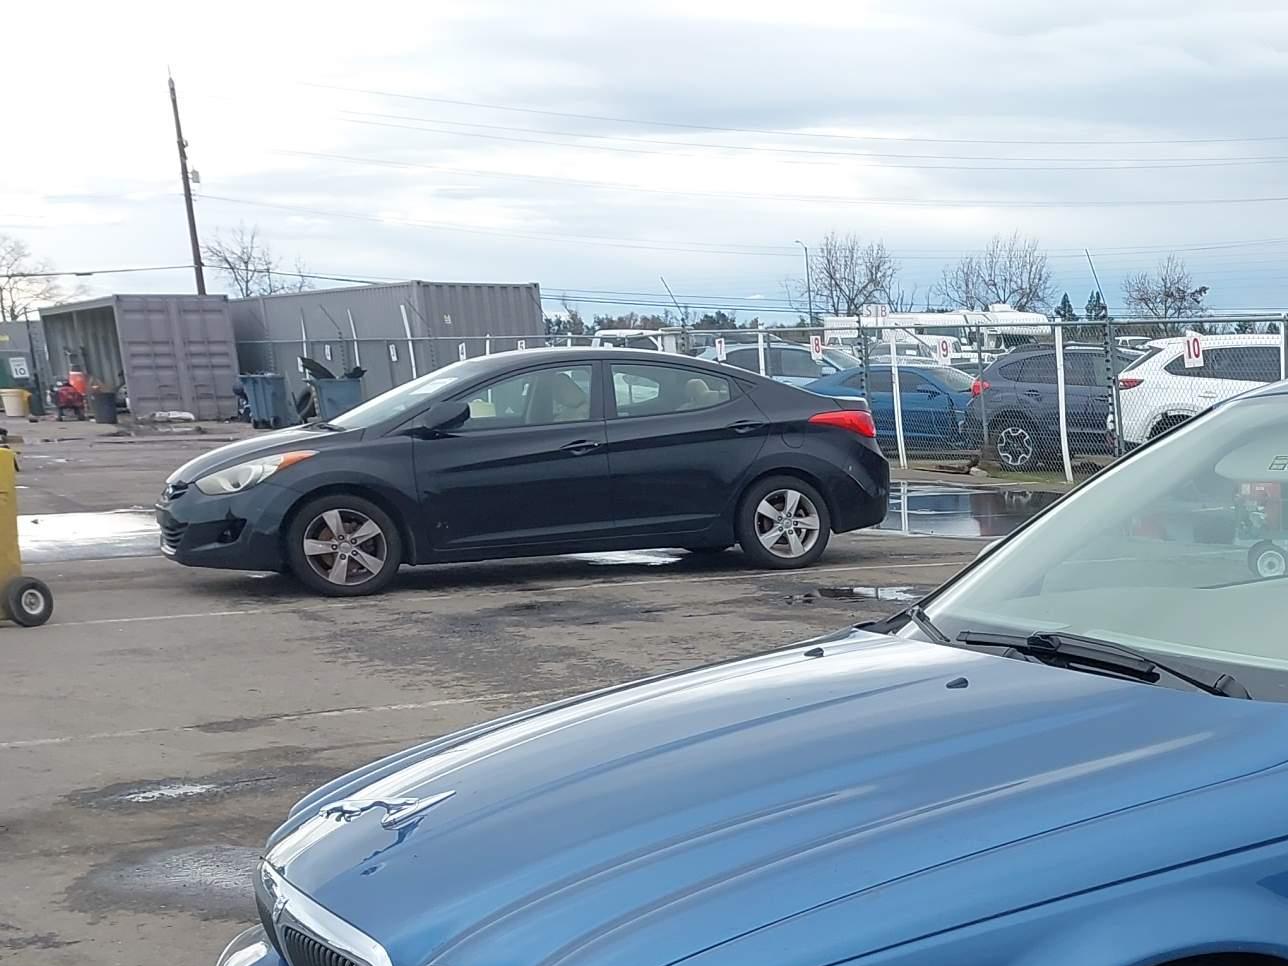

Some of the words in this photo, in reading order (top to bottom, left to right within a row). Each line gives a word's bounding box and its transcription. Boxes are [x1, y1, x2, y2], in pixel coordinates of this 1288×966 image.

[814, 336, 821, 354] 8
[941, 340, 949, 358] 9
[1186, 337, 1200, 358] 10
